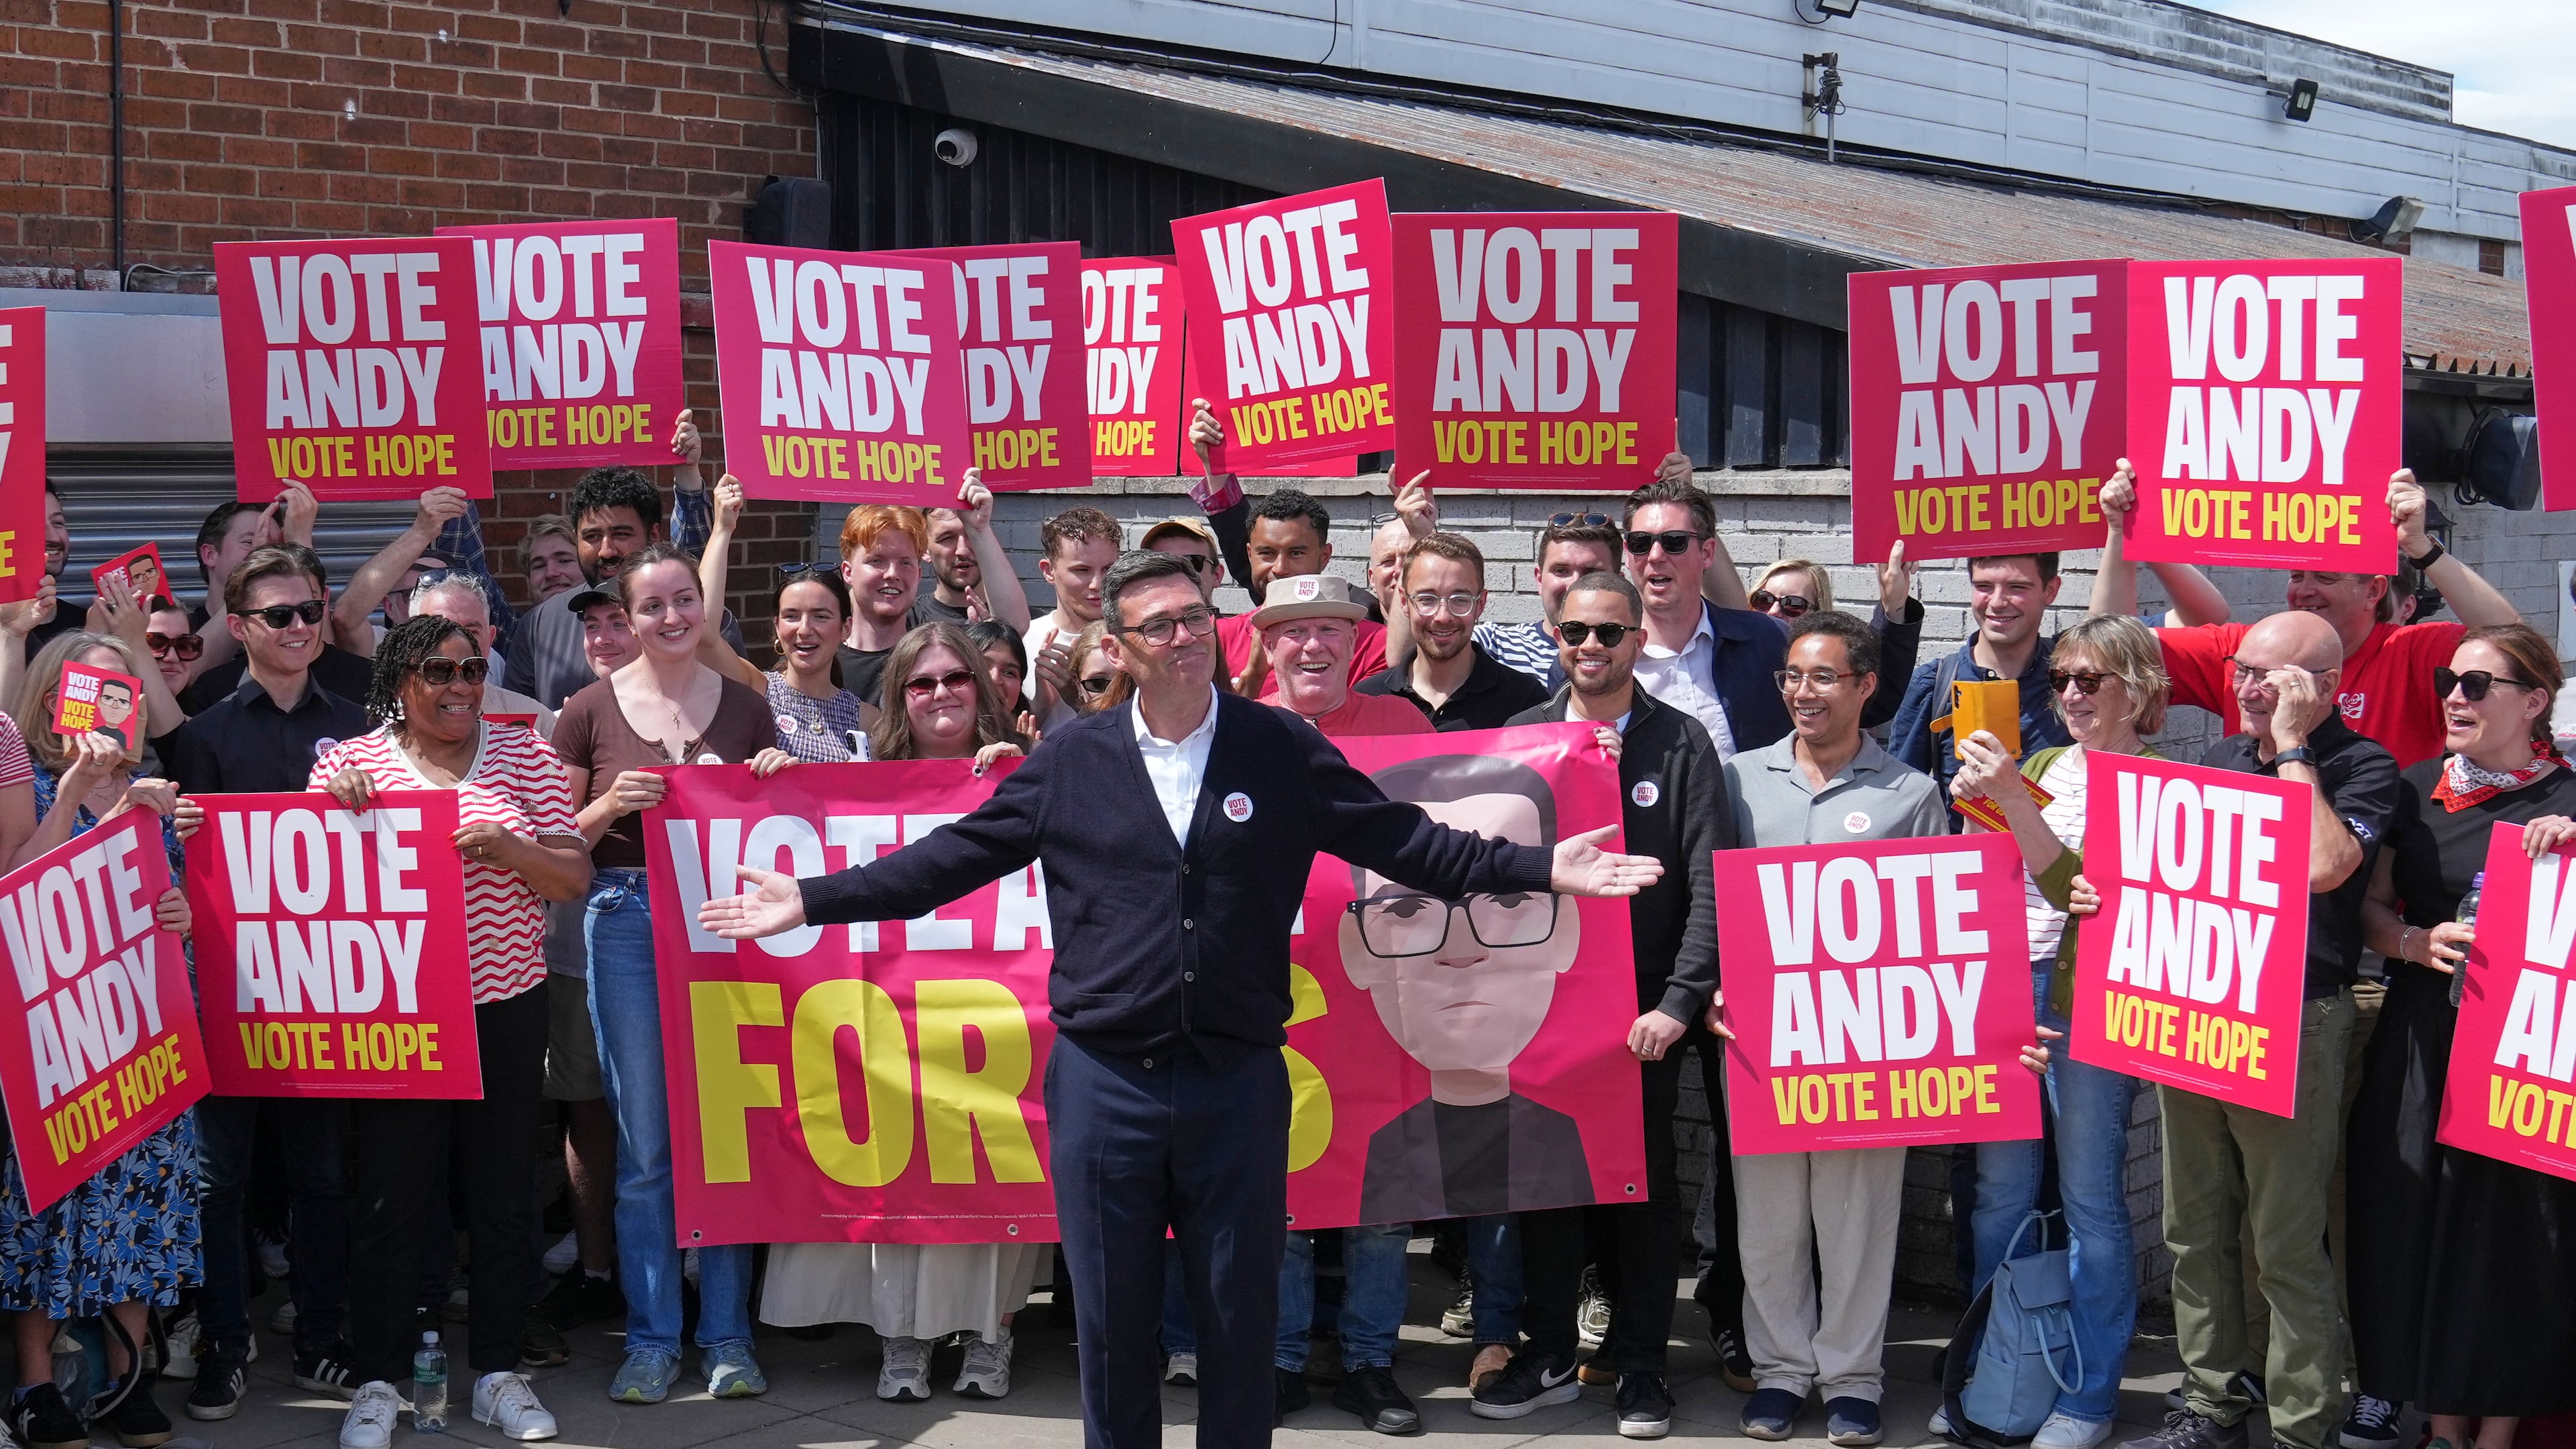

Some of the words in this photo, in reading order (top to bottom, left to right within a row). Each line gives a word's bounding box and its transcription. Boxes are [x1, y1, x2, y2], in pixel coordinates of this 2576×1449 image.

[475, 233, 647, 321] VOTE
[1201, 200, 1369, 313] VOTE
[1431, 227, 1639, 323] VOTE
[250, 253, 445, 344] VOTE
[746, 257, 931, 354] VOTE
[952, 256, 1052, 341] TE
[1081, 268, 1163, 345] OTE
[1889, 275, 2098, 384] VOTE
[2164, 275, 2364, 381] VOTE
[480, 321, 645, 401] ANDY
[961, 345, 1051, 423] DY
[1224, 294, 1370, 398] ANDY
[1433, 329, 1635, 413] ANDY
[267, 347, 444, 429] ANDY
[567, 405, 652, 444] HOPE
[761, 348, 930, 435] ANDY
[1231, 397, 1308, 446] VOTE
[1311, 384, 1393, 435] HOPE
[268, 437, 357, 478] VOTE
[366, 435, 457, 476] HOPE
[763, 435, 849, 479] VOTE
[858, 441, 944, 484] HOPE
[974, 428, 1059, 470] HOPE
[1096, 421, 1156, 456] HOPE
[1434, 421, 1527, 464] VOTE
[1540, 421, 1638, 464] HOPE
[1894, 380, 2096, 480] ANDY
[2162, 386, 2360, 484] ANDY
[1894, 485, 1990, 535] VOTE
[2003, 478, 2099, 528] HOPE
[2162, 488, 2251, 539] VOTE
[2263, 492, 2361, 545] HOPE
[1299, 581, 1315, 589] VOTE
[64, 685, 98, 703] ANDY
[64, 699, 95, 719] VOTE
[68, 671, 100, 691] VOTE
[60, 712, 93, 732] HOPE
[778, 722, 792, 731] ANDY
[780, 717, 794, 728] VOTE
[1228, 798, 1246, 808] VOTE
[1230, 807, 1248, 816] ANDY
[1637, 786, 1653, 794] VOTE
[1847, 820, 1864, 830] ANDY
[1851, 815, 1868, 825] VOTE
[1983, 798, 1997, 810] FOR
[219, 808, 427, 914] VOTE
[2118, 771, 2282, 908] VOTE
[0, 826, 154, 1003] VOTE
[1757, 851, 1989, 965] VOTE
[237, 920, 425, 1013] ANDY
[2106, 886, 2275, 1014] ANDY
[27, 935, 162, 1109] ANDY
[239, 1022, 335, 1069] VOTE
[342, 1023, 442, 1071] HOPE
[1771, 961, 1987, 1067] ANDY
[2106, 991, 2180, 1057] VOTE
[2186, 1011, 2269, 1080] HOPE
[45, 1081, 118, 1165] VOTE
[116, 1034, 186, 1118] HOPE
[690, 979, 1045, 1187] FOR
[1772, 1072, 1878, 1124] VOTE
[1890, 1065, 2000, 1118] HOPE
